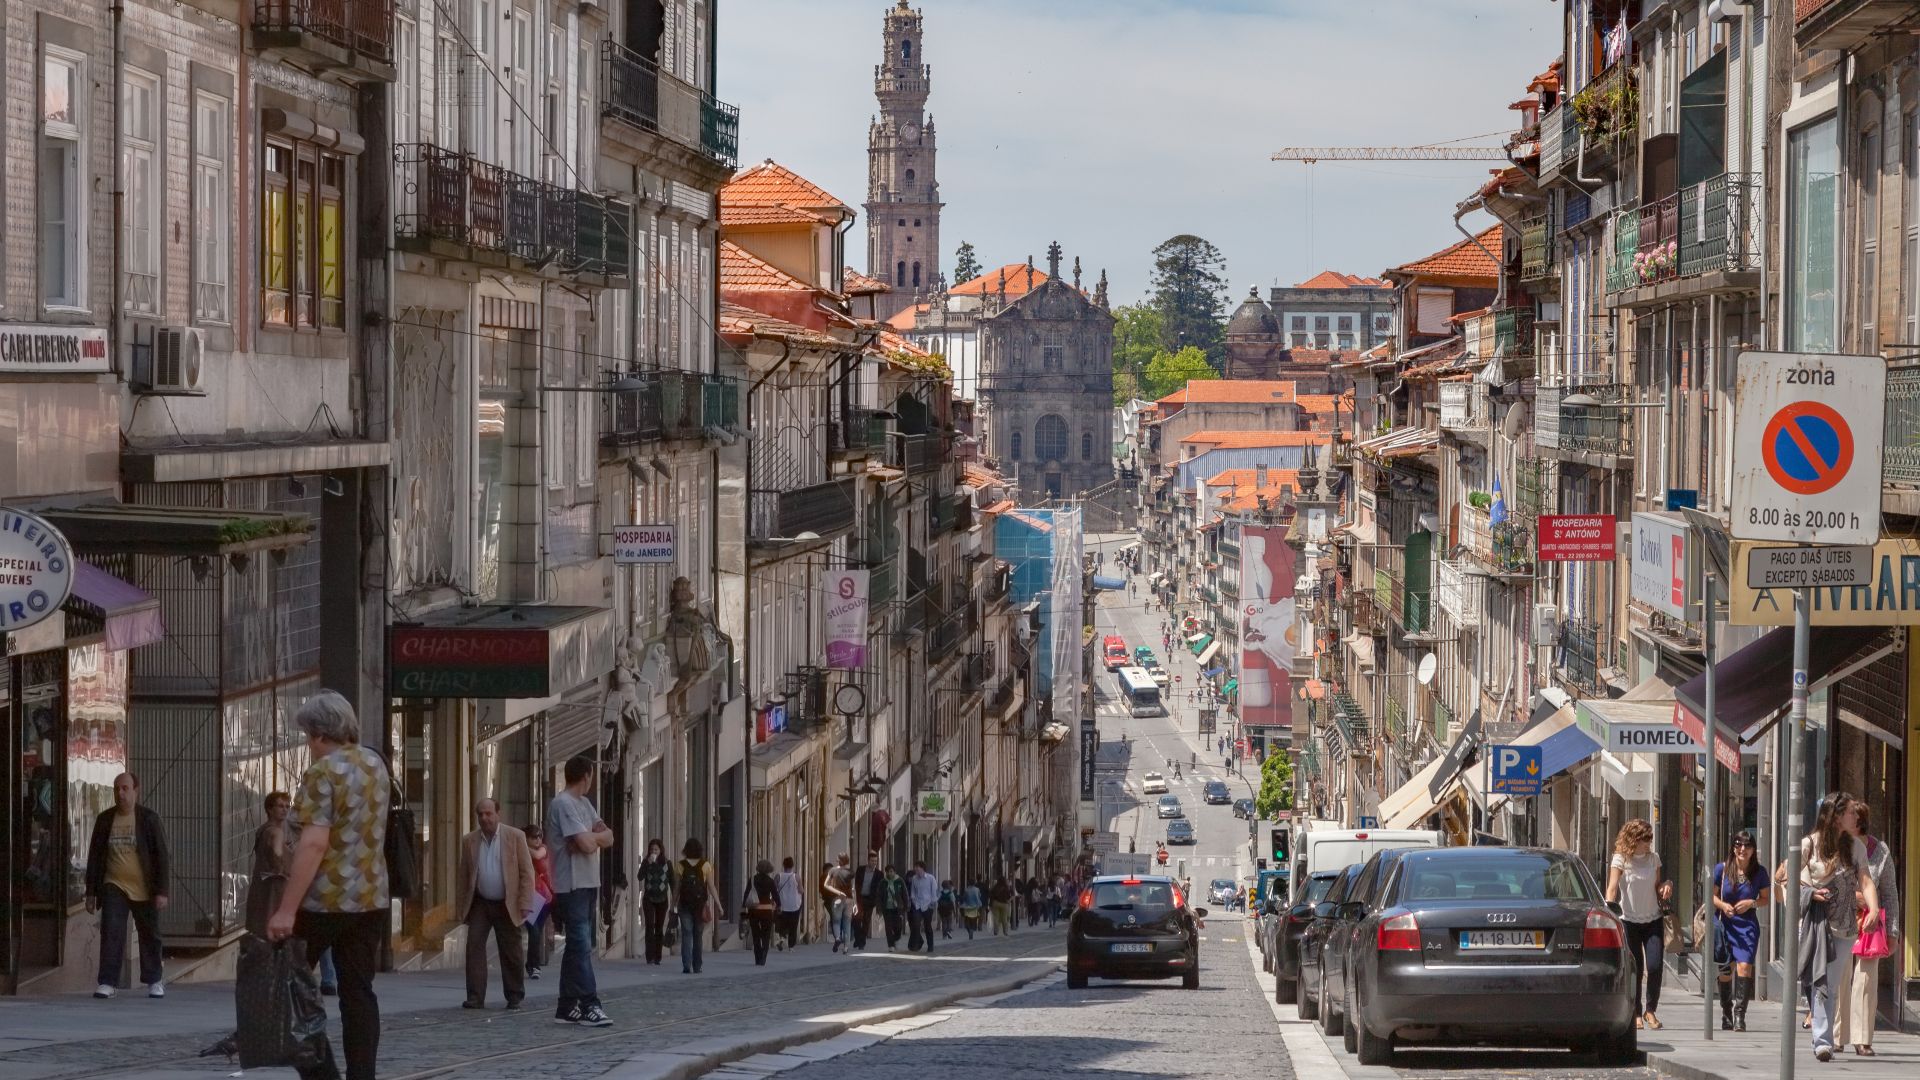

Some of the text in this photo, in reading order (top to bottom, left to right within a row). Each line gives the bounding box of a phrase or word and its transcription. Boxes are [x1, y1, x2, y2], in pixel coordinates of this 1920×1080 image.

[1, 332, 80, 363] CABELEIREIROS
[1786, 367, 1835, 386] zona
[1552, 518, 1603, 528] HOSPEDARIA
[1749, 507, 1860, 530] 8.00 às 20.00 h
[615, 531, 672, 544] HOSPEDARIA
[1565, 528, 1601, 538] ANTÓNIO
[625, 548, 635, 558] de
[637, 547, 673, 558] JANEIRO
[1770, 549, 1852, 565] PAGO DIAS ÚTEIS
[1765, 567, 1855, 584] EXCEPTO SÁBADOS
[402, 637, 540, 659] CHARMODA
[1619, 730, 1695, 745] HOMEO
[1500, 748, 1521, 776] P
